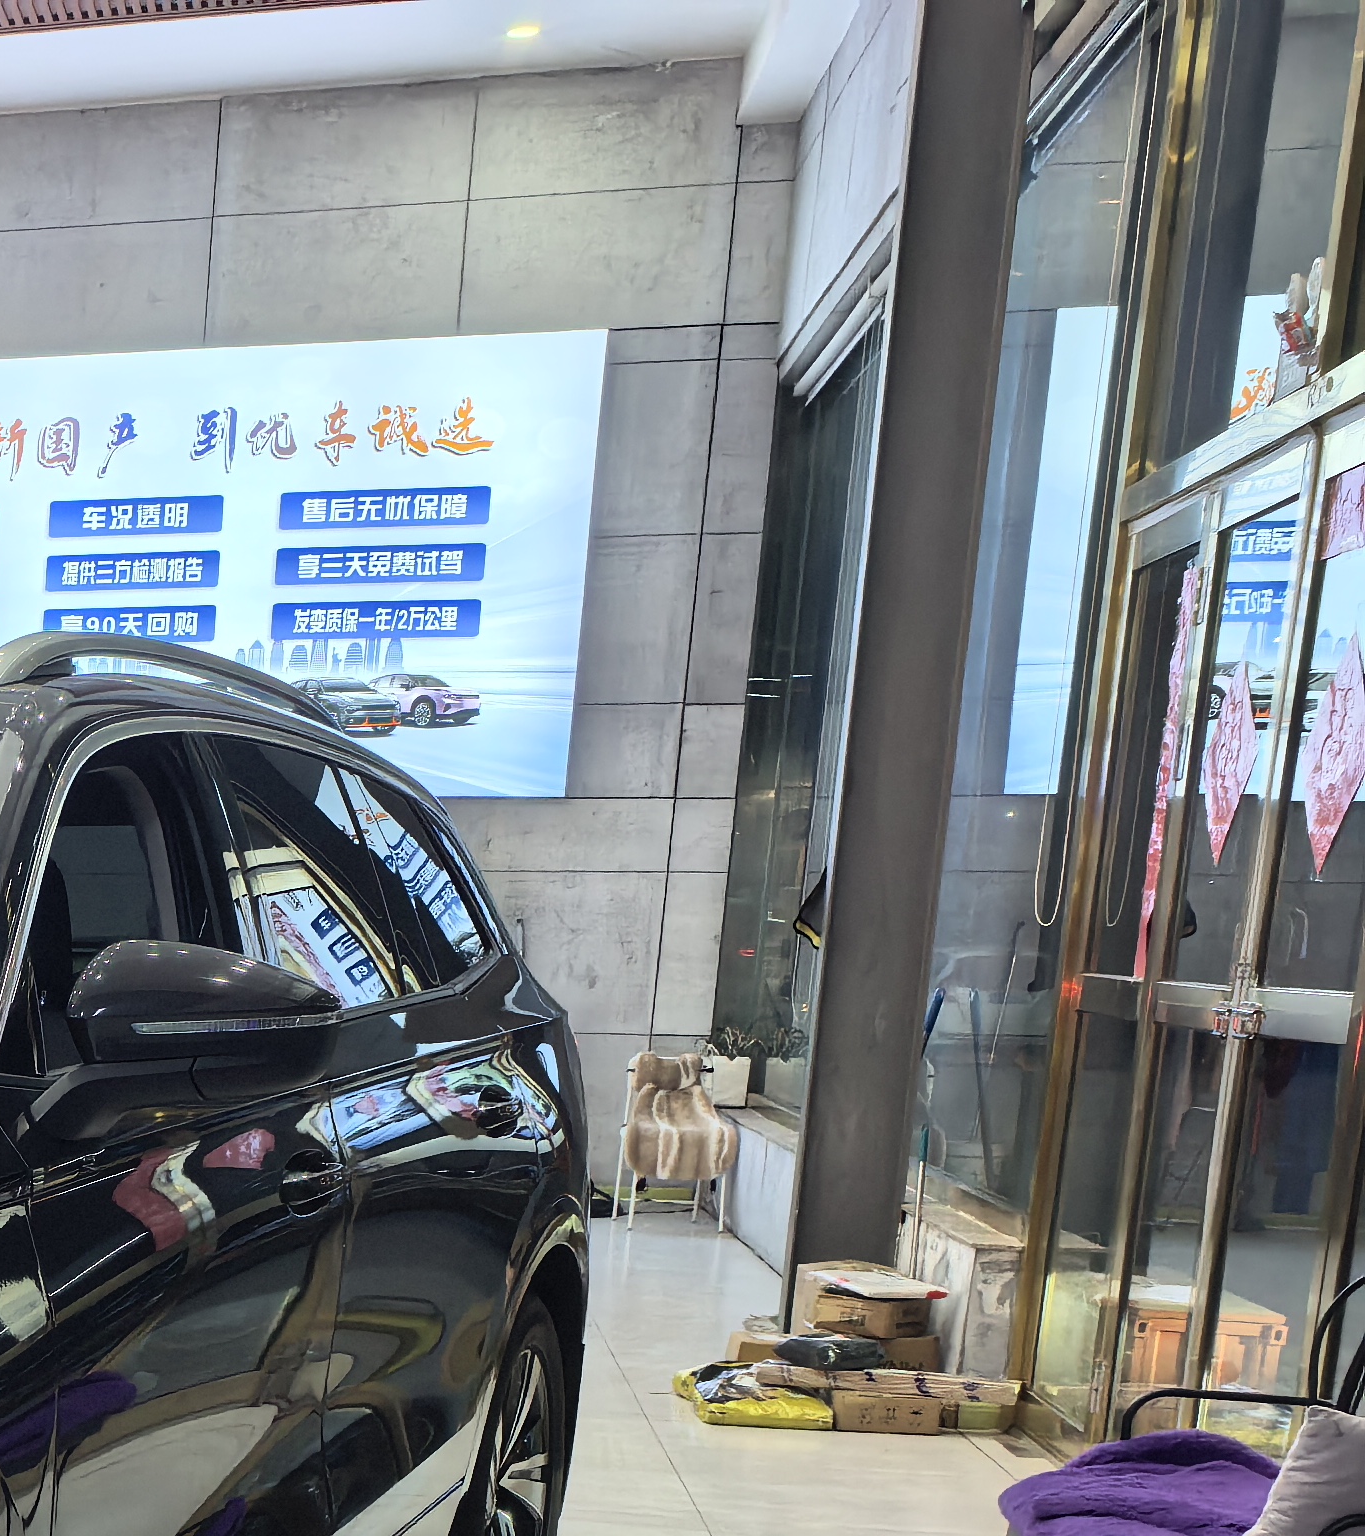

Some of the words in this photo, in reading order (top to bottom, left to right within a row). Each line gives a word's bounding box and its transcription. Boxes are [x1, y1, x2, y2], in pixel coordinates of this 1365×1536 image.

[81, 502, 190, 531] 车况透明
[301, 493, 469, 523] 售后无忧保障
[61, 556, 204, 586] 提供三方检测报告
[297, 549, 464, 579] 享三天免费试驾
[292, 606, 459, 634] 发变质保一年/2万公里
